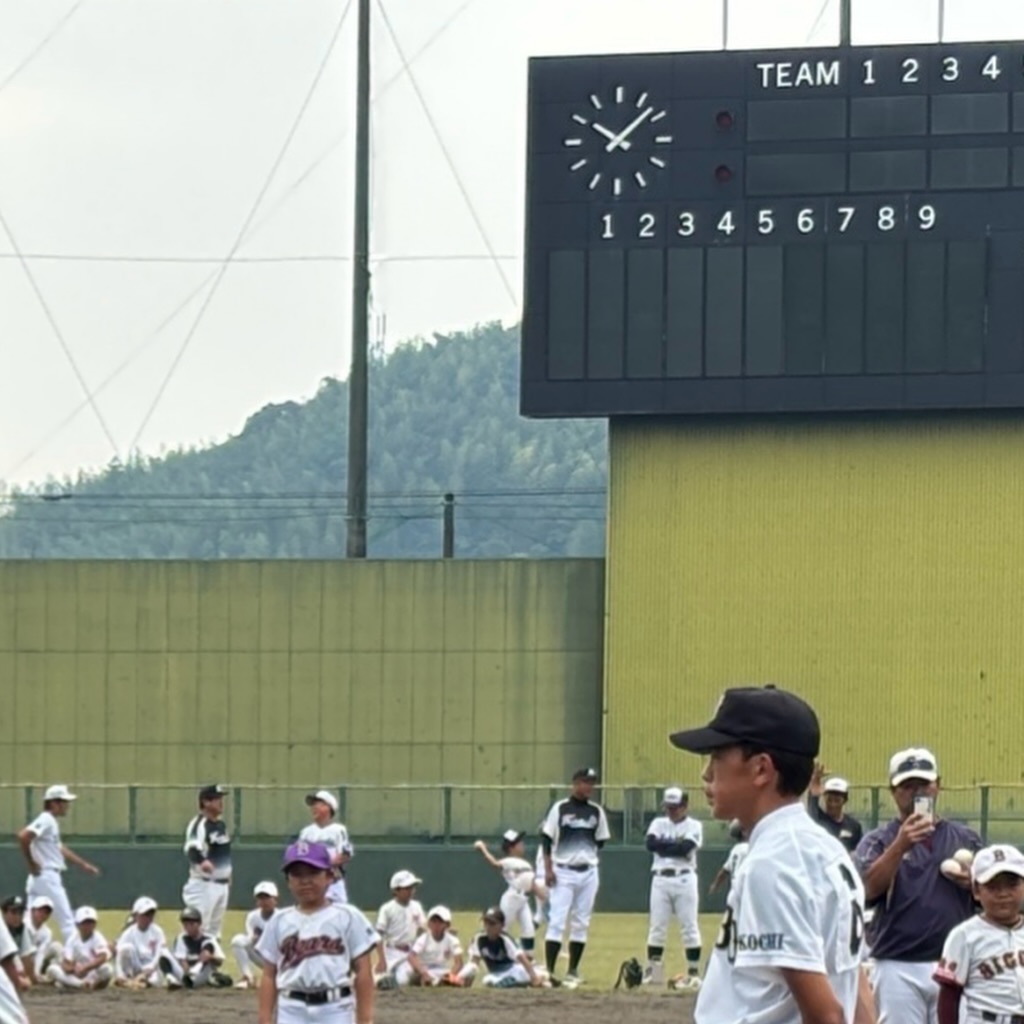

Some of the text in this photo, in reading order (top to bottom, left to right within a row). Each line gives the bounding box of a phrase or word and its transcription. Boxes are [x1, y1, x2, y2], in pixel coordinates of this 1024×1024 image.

[756, 55, 1001, 88] TEAM 1 2 3 4
[602, 205, 936, 238] 1 2 3 4 5 6 7 8 9
